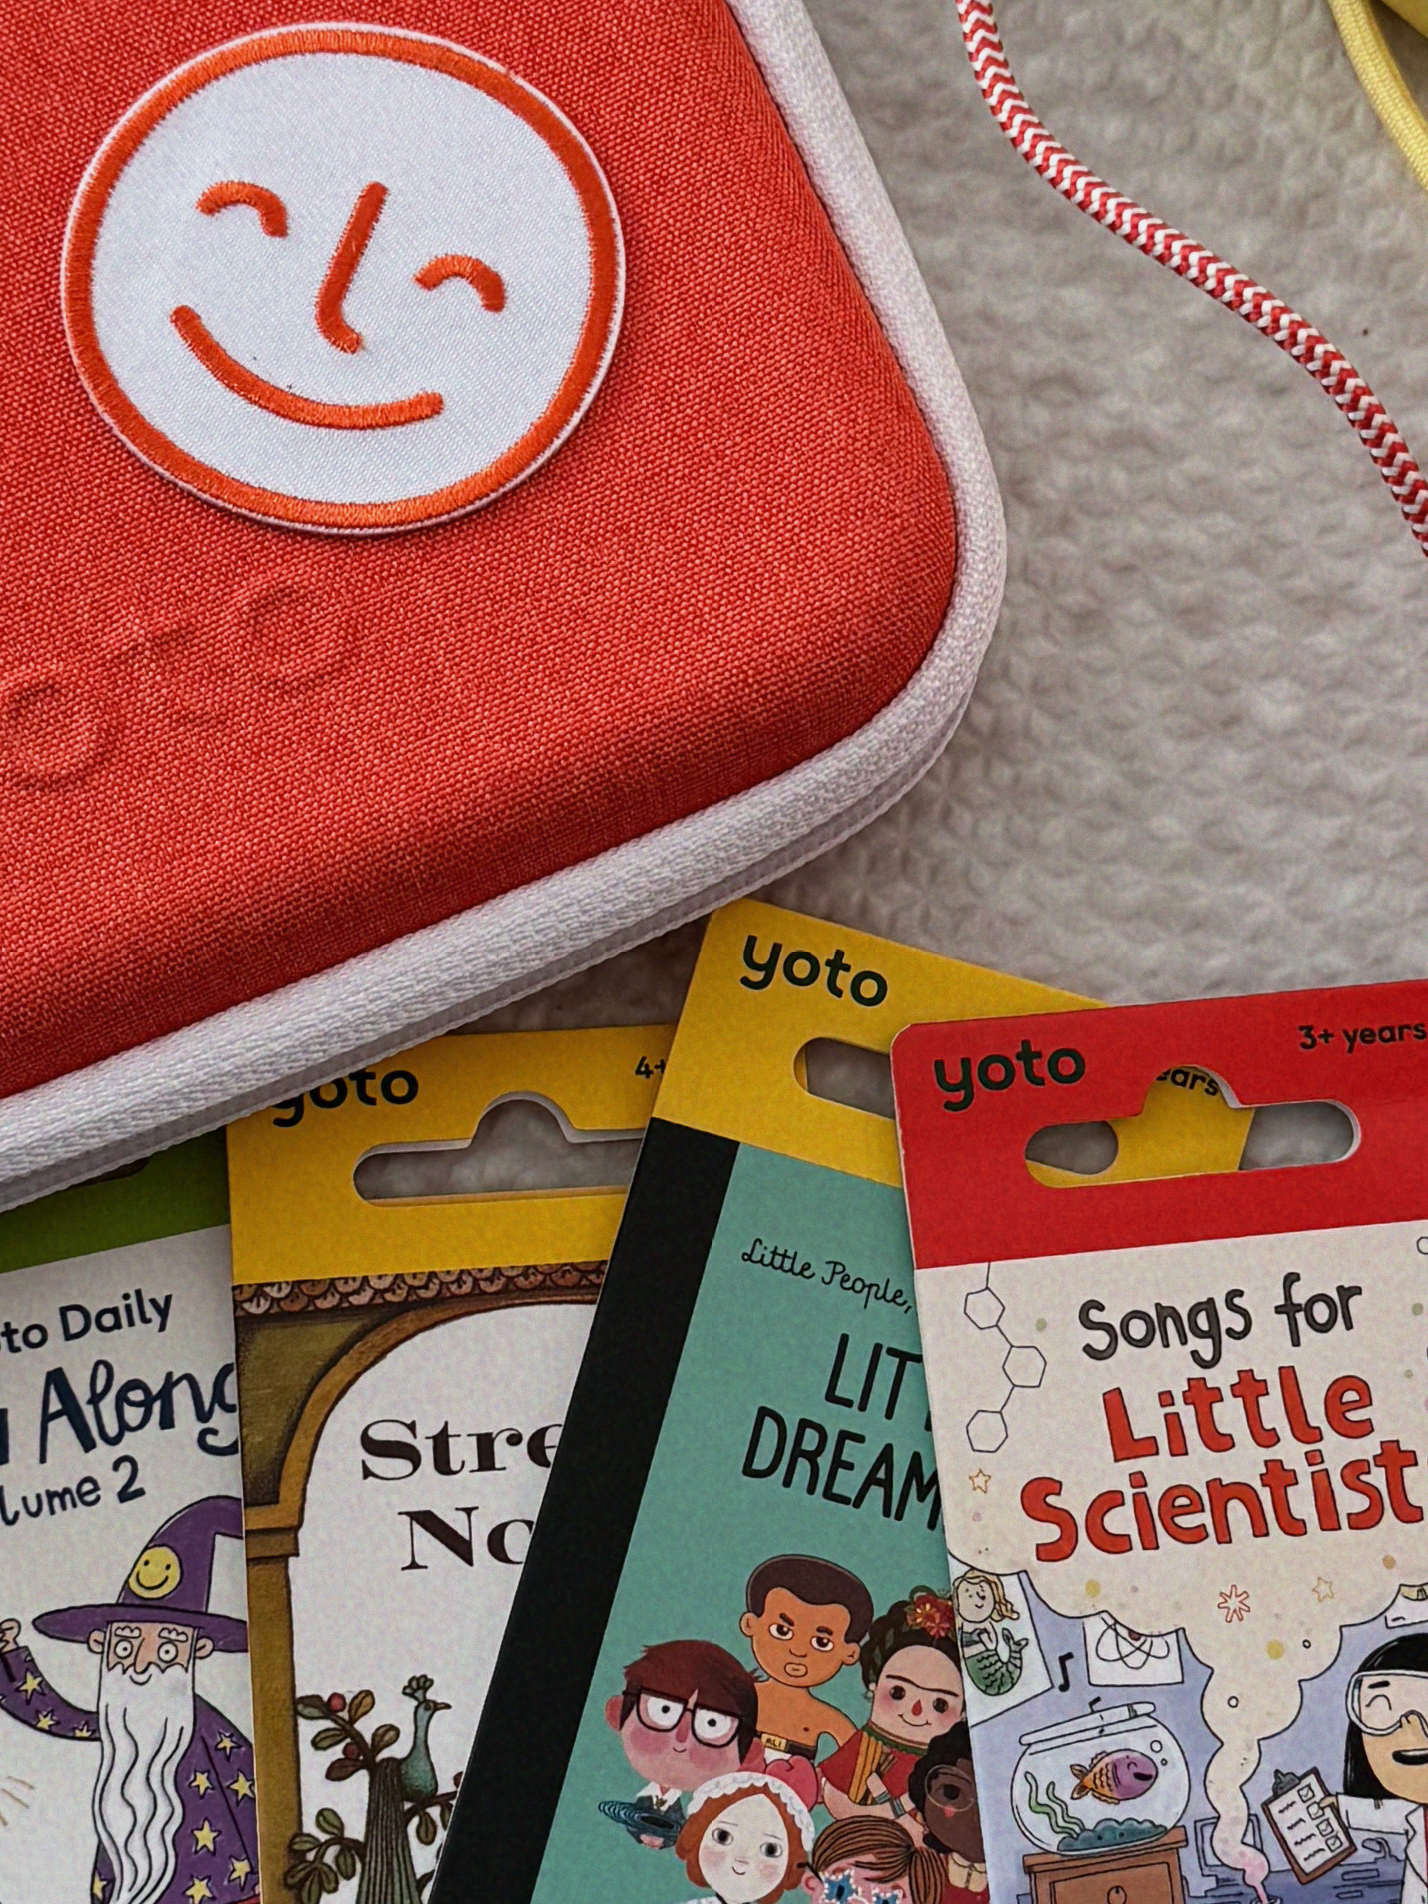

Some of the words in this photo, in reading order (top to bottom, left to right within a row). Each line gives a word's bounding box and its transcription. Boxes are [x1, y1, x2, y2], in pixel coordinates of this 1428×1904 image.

[740, 935, 888, 1007] yoto
[1298, 1024, 1335, 1050] 3+
[1343, 1020, 1428, 1055] years
[934, 1039, 1086, 1112] yoto
[1156, 1068, 1218, 1096] ars
[60, 1288, 174, 1333] Daily
[741, 1238, 816, 1279] Little
[822, 1261, 912, 1314] People,
[1078, 1288, 1253, 1368] Songs
[1274, 1271, 1362, 1347] for
[824, 1333, 932, 1432] LIT
[1101, 1366, 1374, 1463] Little
[112, 1454, 146, 1504] 2
